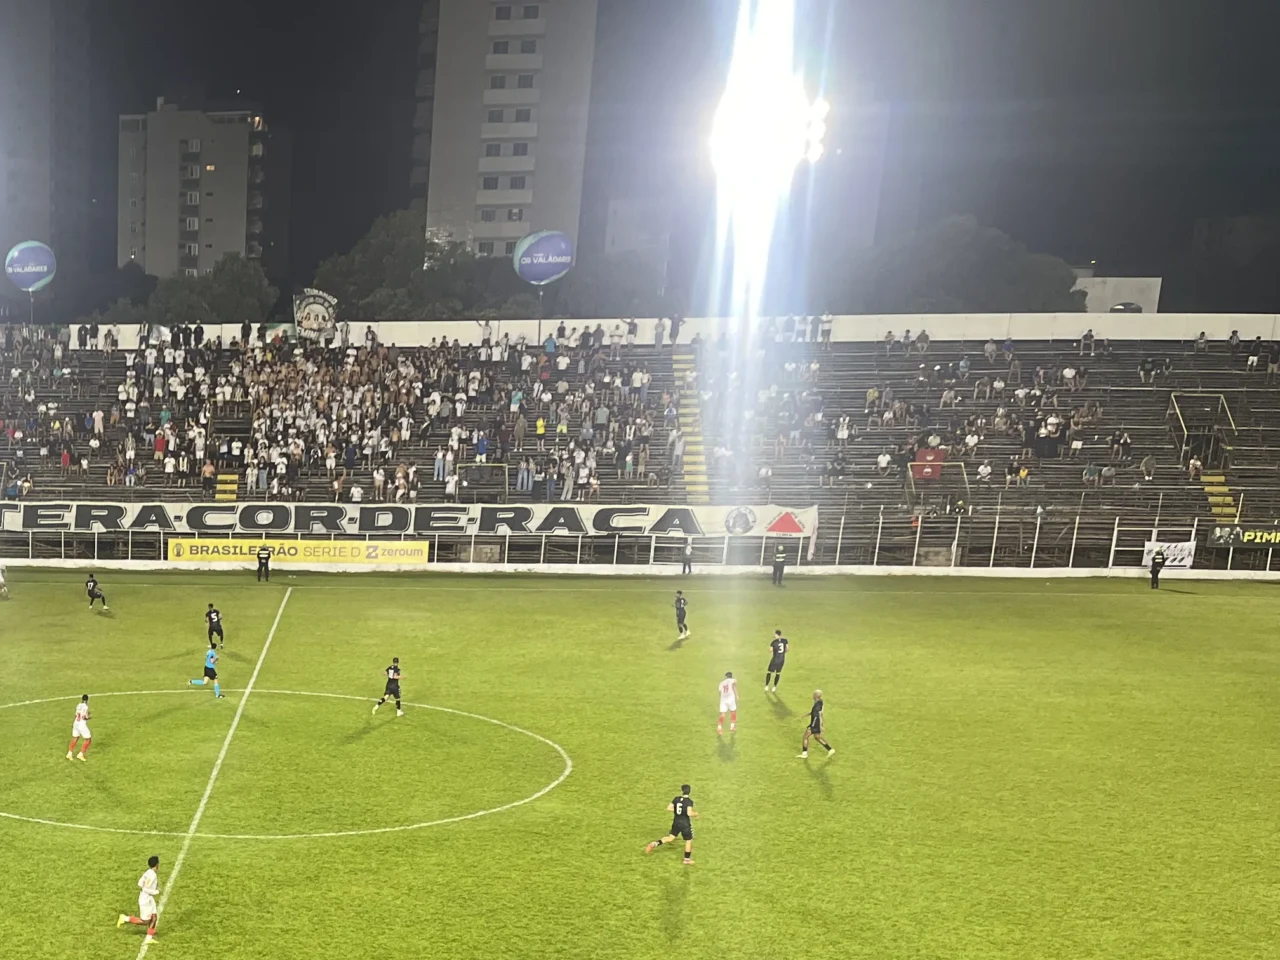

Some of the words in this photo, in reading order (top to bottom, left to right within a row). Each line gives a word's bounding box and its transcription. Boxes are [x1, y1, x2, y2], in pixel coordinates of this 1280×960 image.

[351, 546, 361, 557] D
[381, 548, 423, 556] zeroum
[210, 613, 217, 622] 5
[777, 643, 783, 653] 3
[676, 803, 682, 815] 6
